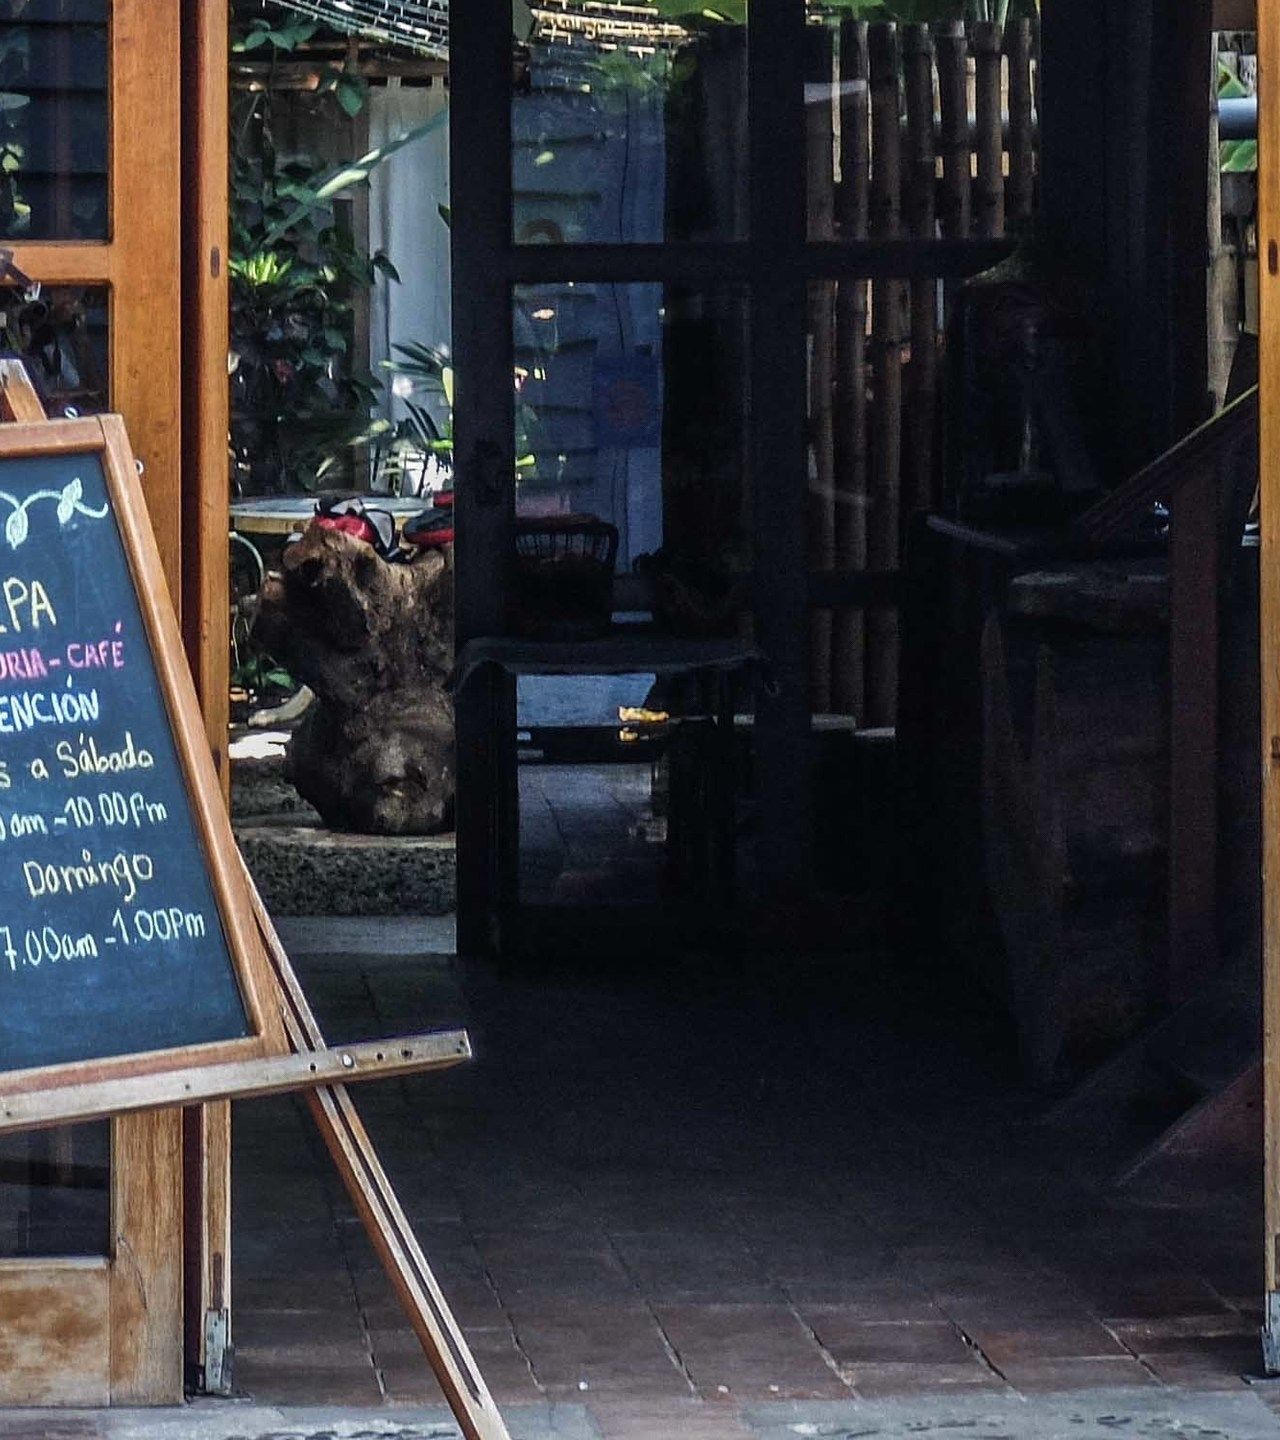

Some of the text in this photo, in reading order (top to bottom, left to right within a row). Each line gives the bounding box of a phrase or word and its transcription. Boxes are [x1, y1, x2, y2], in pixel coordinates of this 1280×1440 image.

[31, 758, 49, 779] a
[56, 731, 154, 778] Sábado
[23, 848, 154, 902] Domingo
